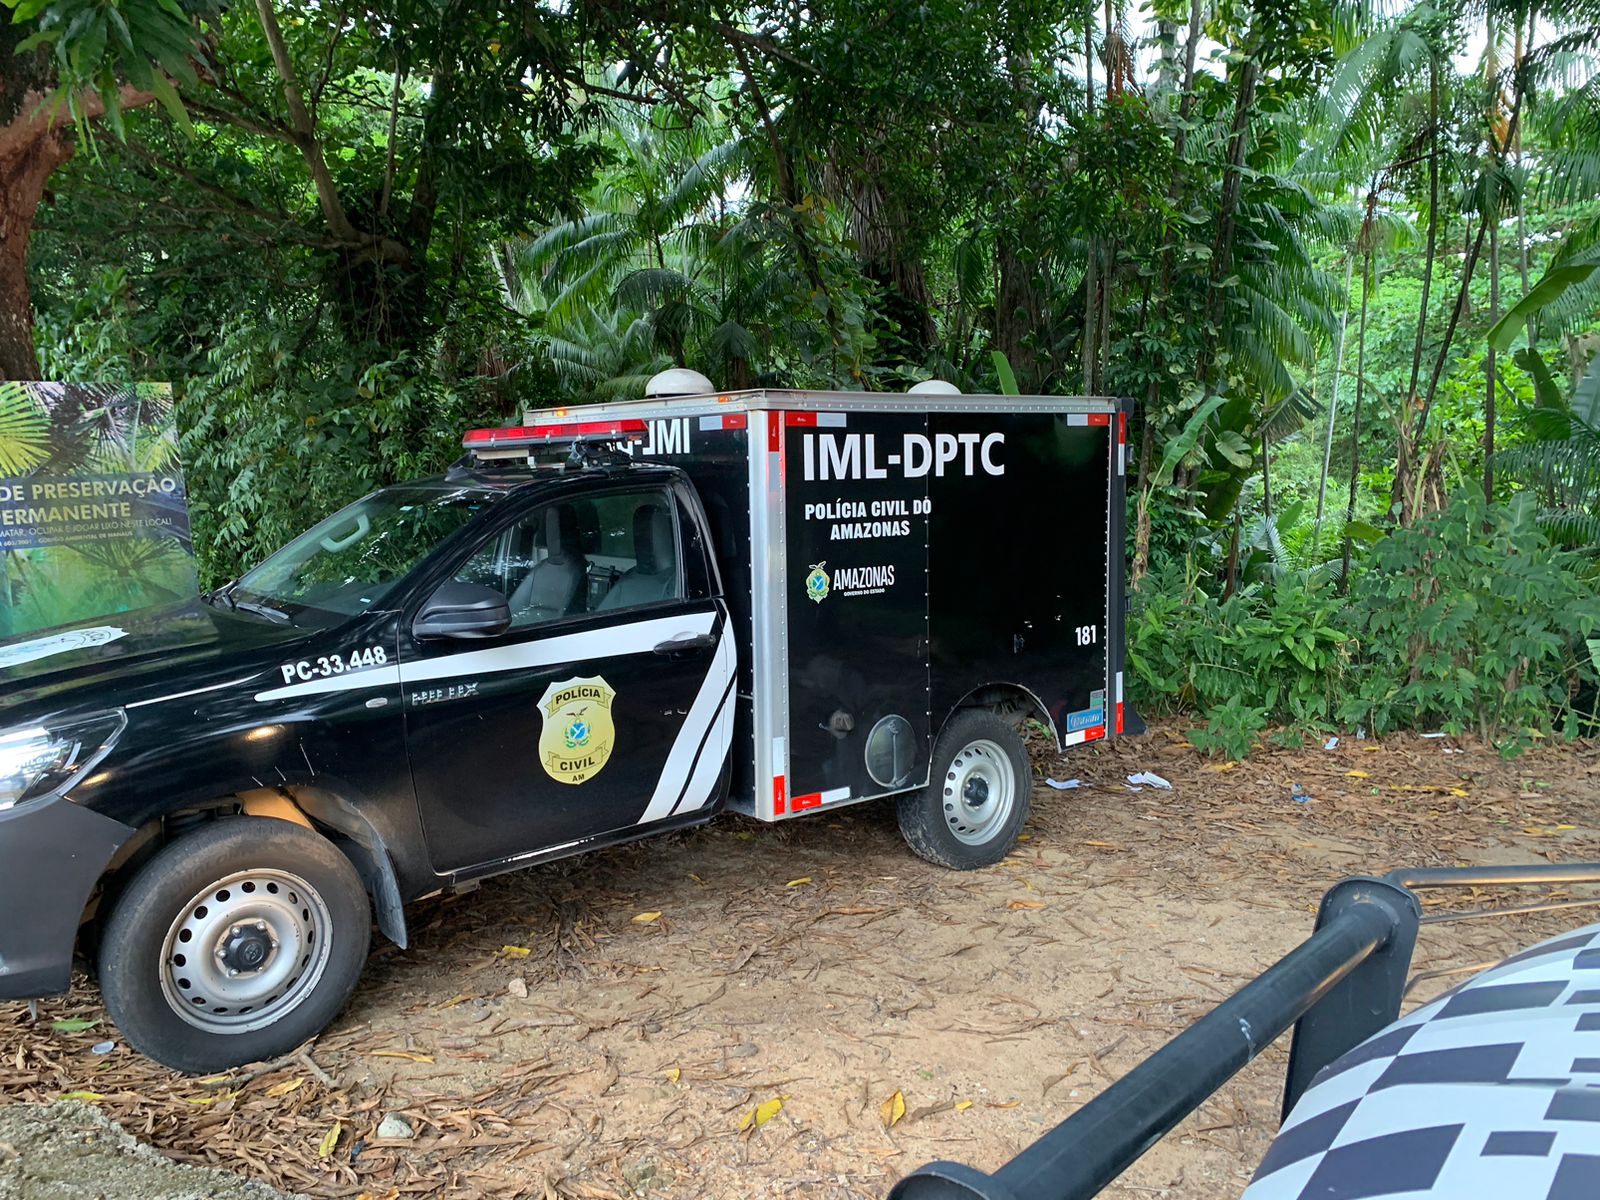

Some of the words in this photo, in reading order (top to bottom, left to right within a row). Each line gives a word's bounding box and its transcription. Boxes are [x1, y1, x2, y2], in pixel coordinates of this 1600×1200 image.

[803, 432, 1006, 481] IML-DPTC
[31, 475, 176, 500] PRESERVAÇÃO
[0, 502, 132, 526] ERMANENTE
[804, 497, 867, 520] POLÍCIA
[871, 499, 909, 518] CIVIL
[912, 498, 933, 516] DO
[72, 523, 100, 533] JOGAR
[101, 521, 119, 530] LIXO
[120, 519, 144, 529] NESTE
[830, 520, 911, 541] AMAZONAS
[832, 564, 895, 591] AMAZONAS
[1075, 625, 1097, 647] 181
[280, 645, 388, 684] PC-33.448
[555, 686, 601, 705] POLÍCIA
[560, 756, 595, 771] CIVIL
[572, 773, 585, 782] AM
